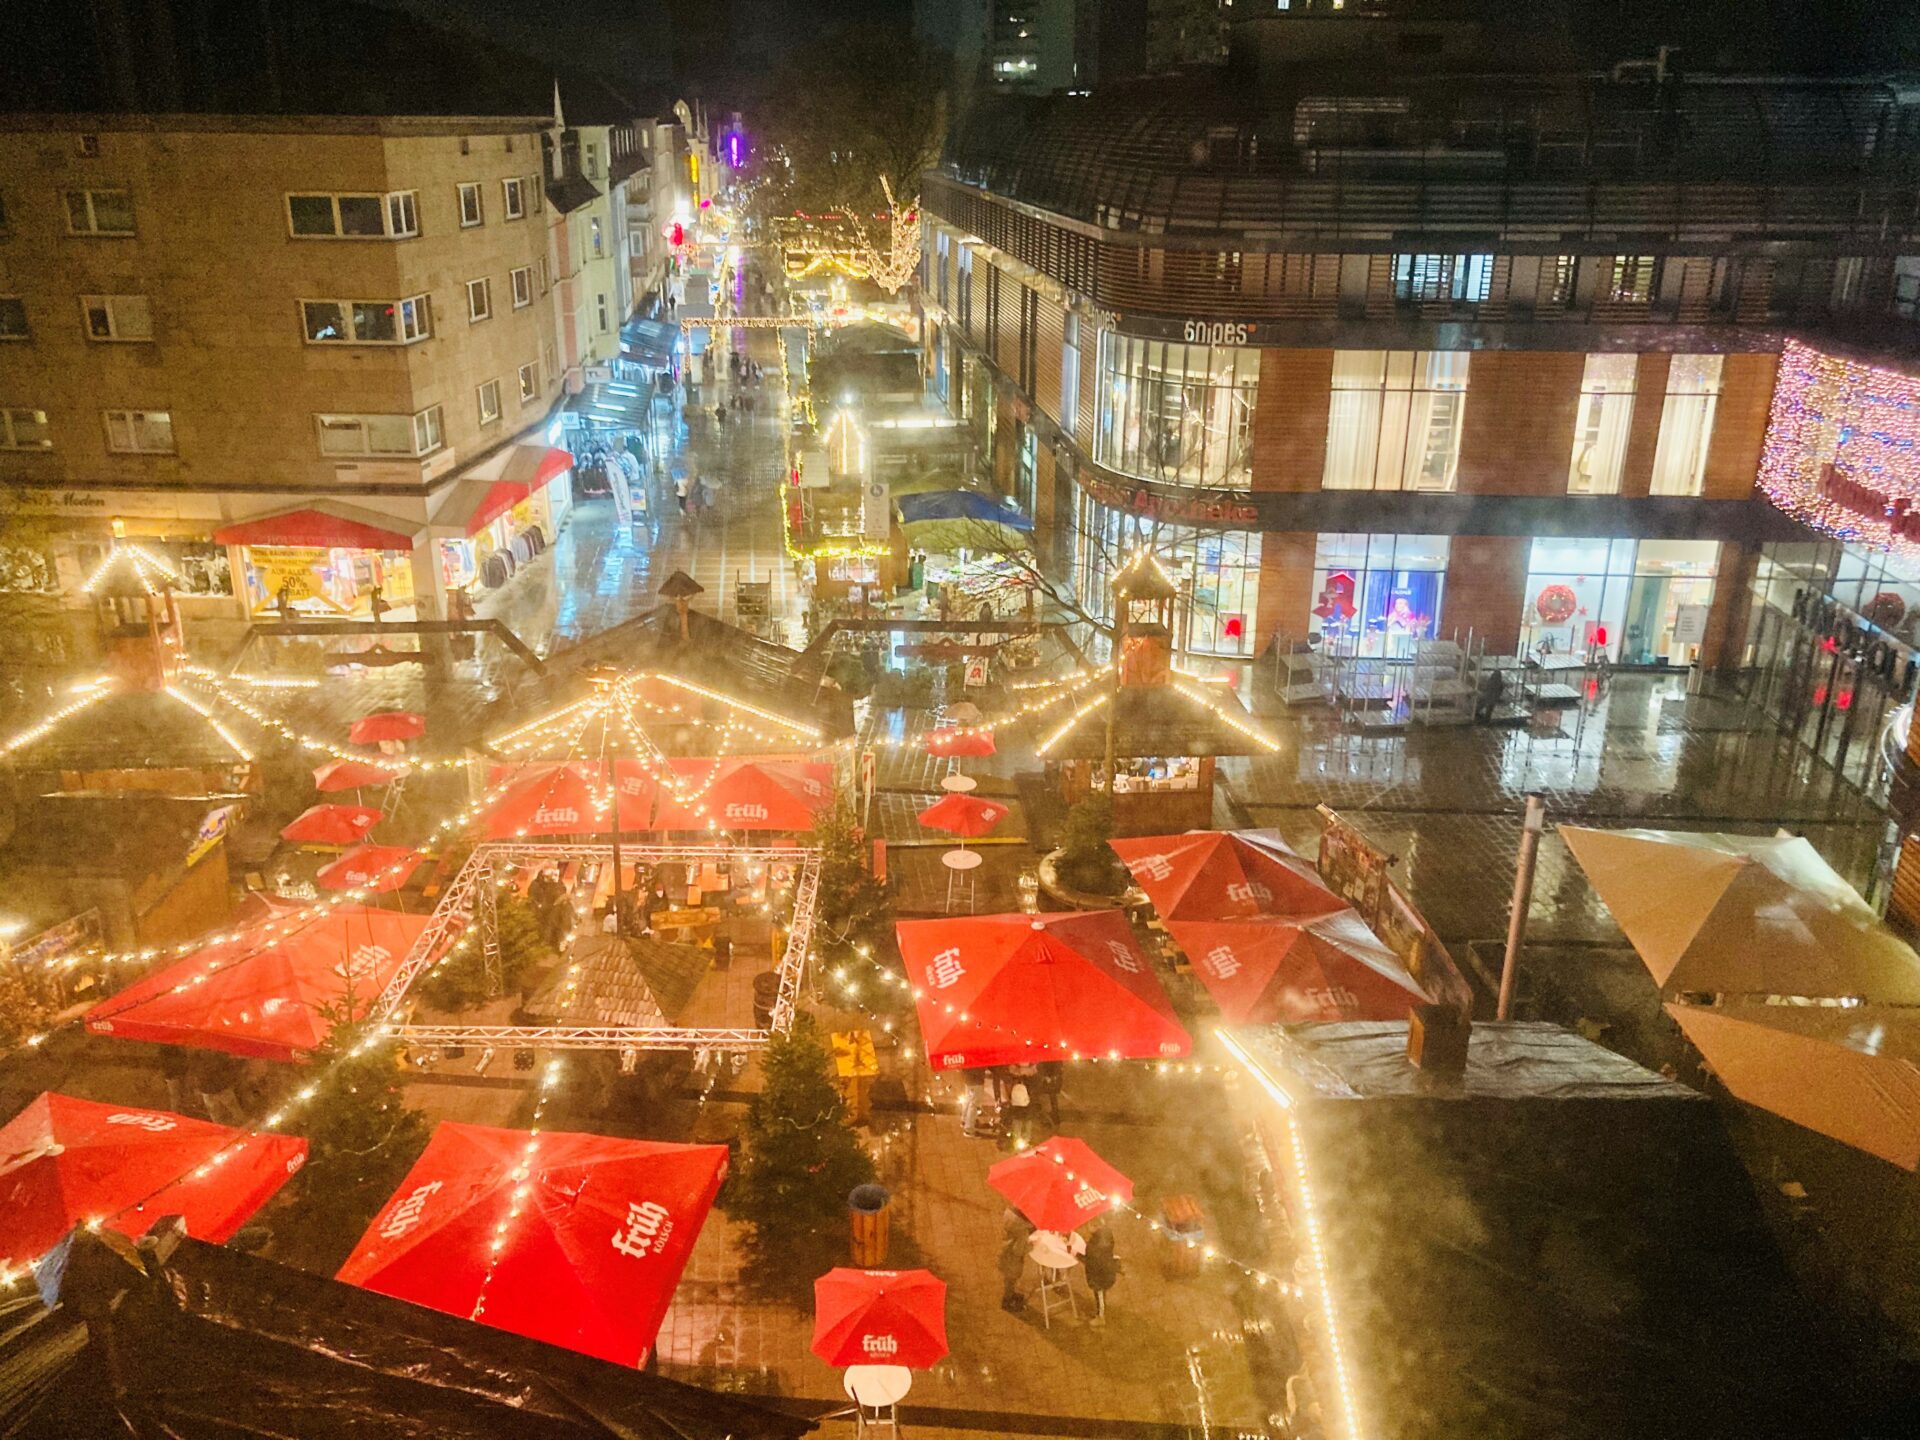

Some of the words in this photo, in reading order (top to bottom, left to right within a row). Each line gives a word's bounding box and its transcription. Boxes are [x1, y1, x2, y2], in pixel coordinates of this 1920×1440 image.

[281, 576, 308, 588] 50%
[535, 807, 579, 824] früh
[724, 803, 769, 821] früh
[1225, 882, 1273, 901] früh
[933, 947, 966, 989] früh
[1207, 945, 1242, 979] früh
[1160, 1043, 1181, 1054] früh
[943, 1054, 965, 1066] früh
[381, 1181, 443, 1239] früh
[611, 1201, 669, 1259] früh
[642, 1220, 674, 1255] KÖLSCH
[862, 1333, 898, 1355] früh
